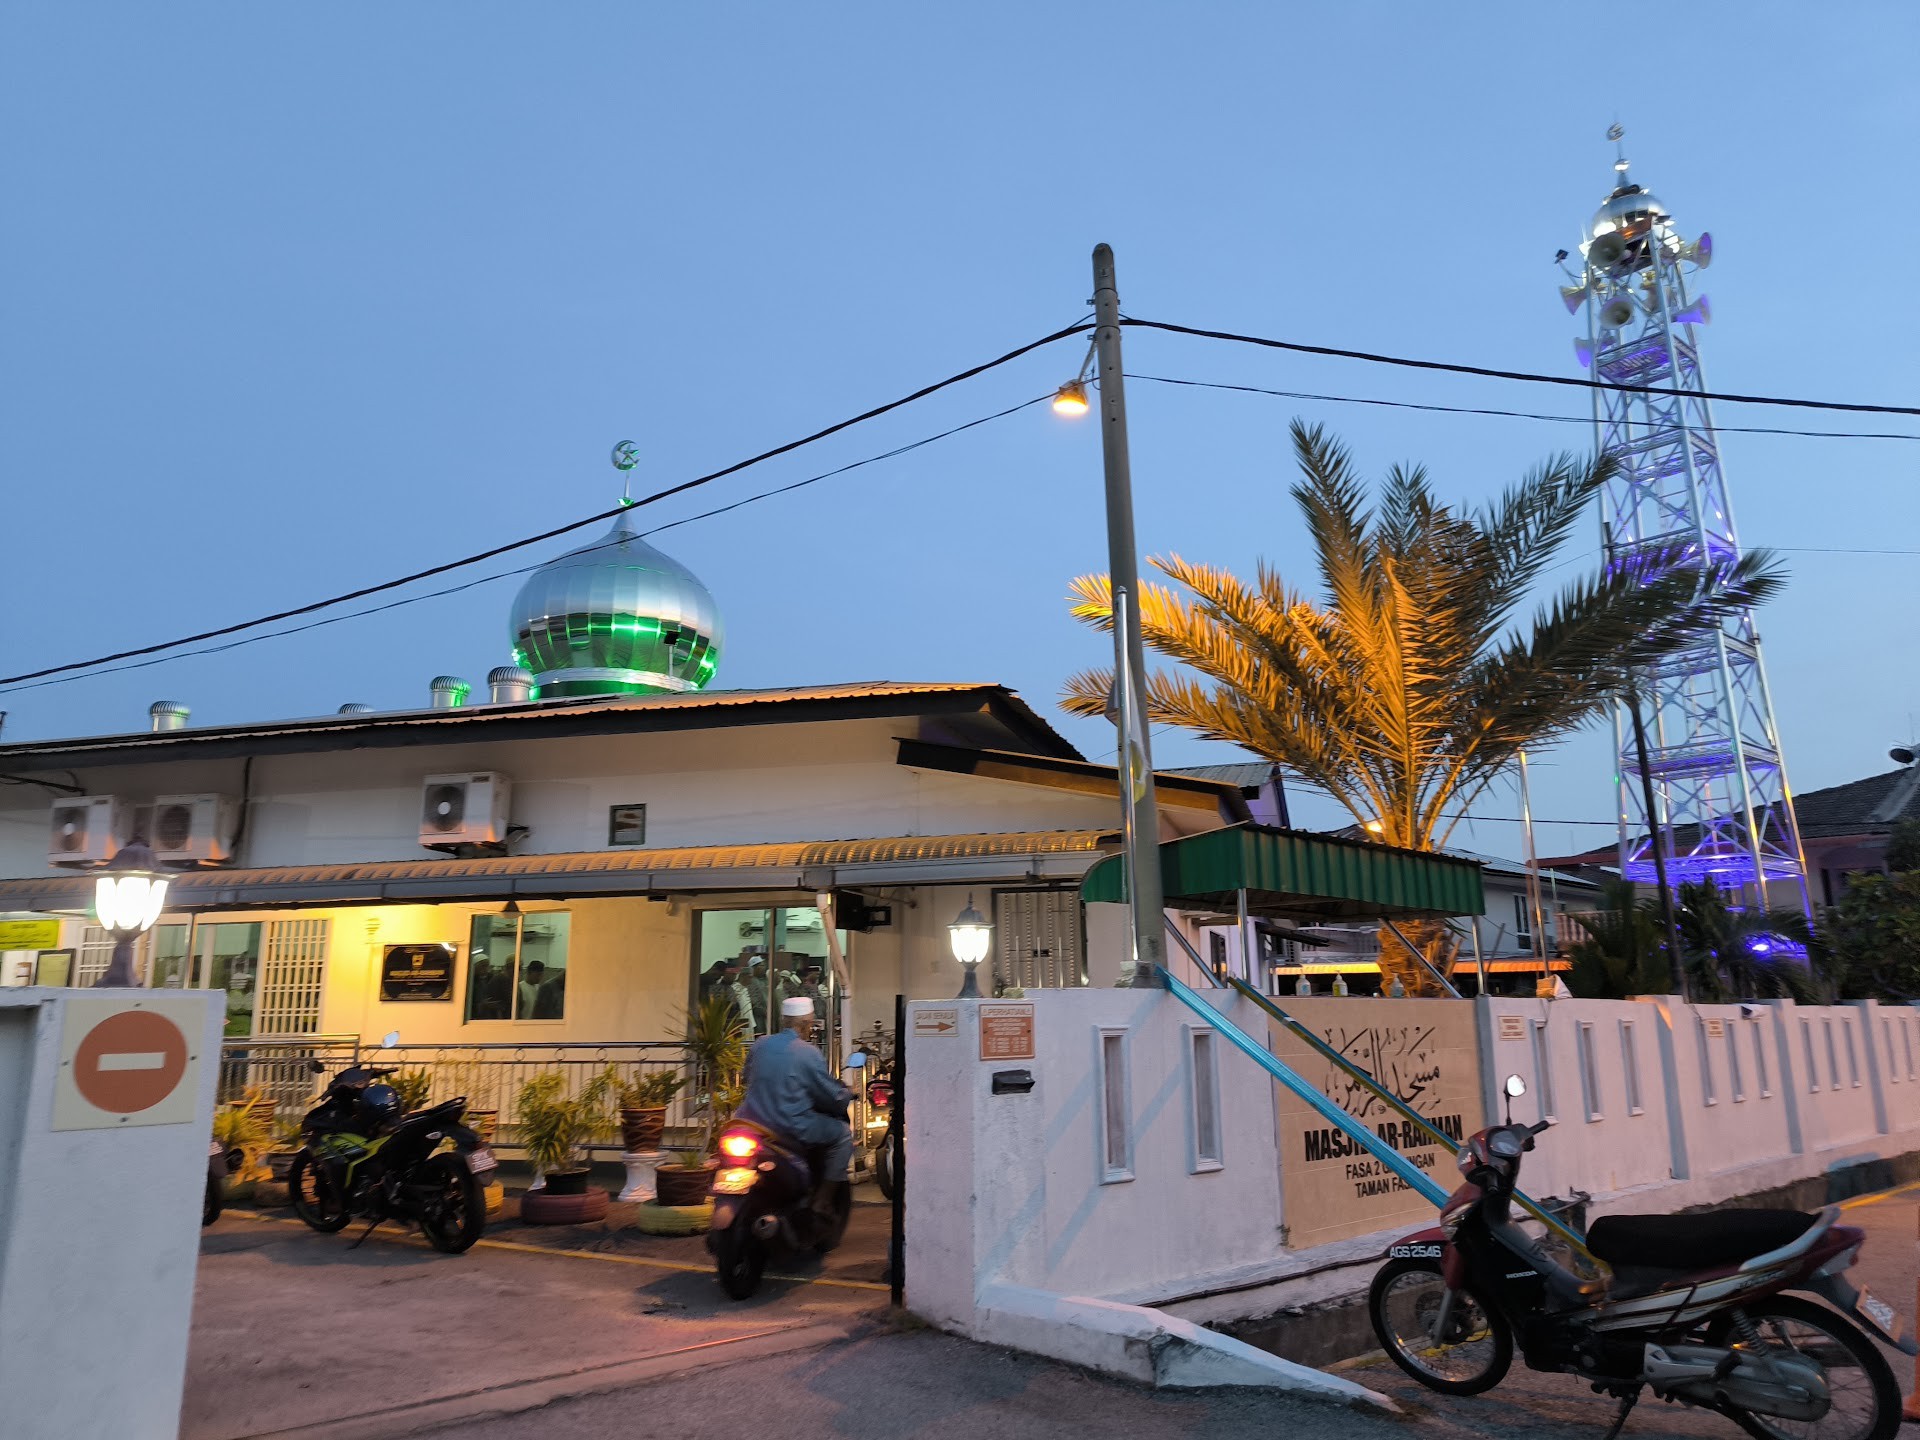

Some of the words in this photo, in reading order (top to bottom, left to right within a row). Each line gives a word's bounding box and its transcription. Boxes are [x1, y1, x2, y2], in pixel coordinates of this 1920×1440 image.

[1346, 1161, 1373, 1180] FASA
[1374, 1160, 1381, 1176] 2
[1355, 1178, 1390, 1198] TAMAN
[1390, 1245, 1411, 1258] AGS
[1412, 1245, 1442, 1258] 2546
